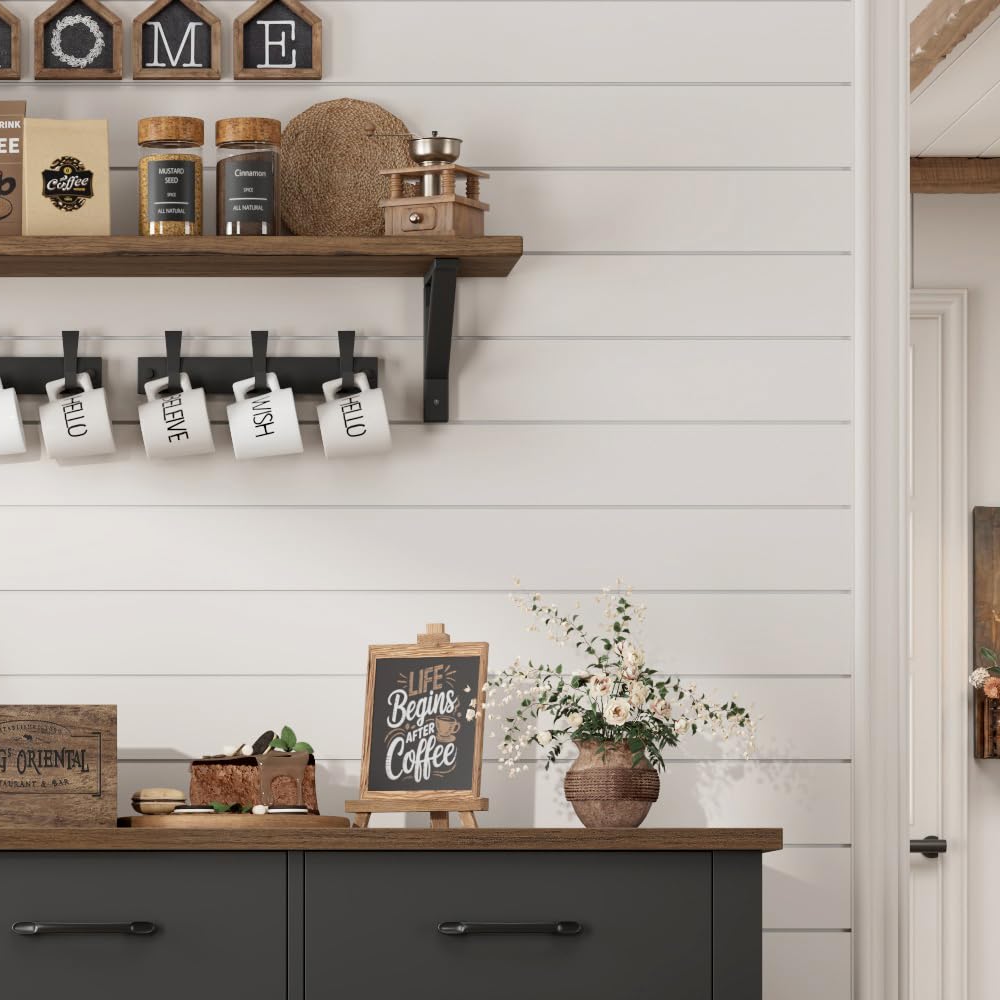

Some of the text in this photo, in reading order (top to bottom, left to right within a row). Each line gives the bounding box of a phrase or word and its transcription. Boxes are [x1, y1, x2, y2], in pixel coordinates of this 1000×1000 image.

[145, 21, 203, 67] M
[256, 20, 296, 69] E
[46, 175, 89, 191] Coffee
[234, 169, 267, 177] Cinnamon
[62, 397, 88, 438] HELLO
[252, 395, 275, 438] WISH
[341, 397, 366, 438] HELLO
[408, 664, 444, 696] LIFE
[387, 689, 458, 729] Begins
[406, 722, 435, 744] AFTER
[17, 747, 90, 775] ORIENTAL
[385, 735, 457, 783] Coffee
